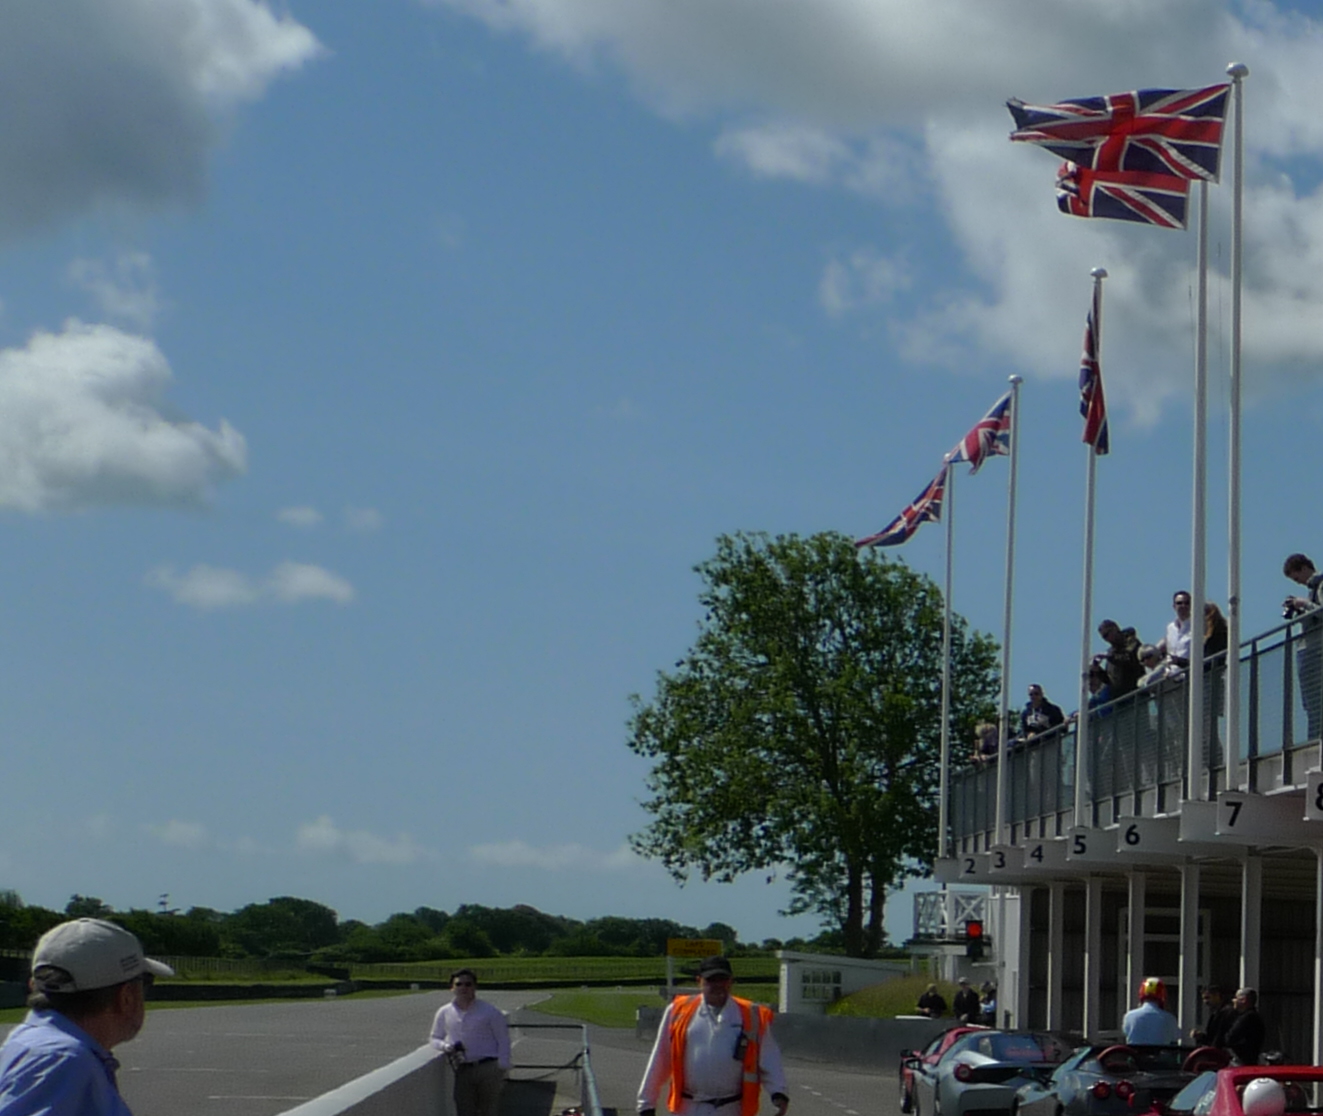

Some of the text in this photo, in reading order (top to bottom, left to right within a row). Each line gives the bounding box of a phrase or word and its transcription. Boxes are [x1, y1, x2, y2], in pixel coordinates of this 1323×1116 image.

[1225, 801, 1243, 827] 7
[1073, 834, 1087, 855] 5
[1125, 824, 1141, 846] 6
[994, 851, 1006, 869] 3
[1031, 845, 1044, 863] 4
[964, 858, 976, 874] 2
